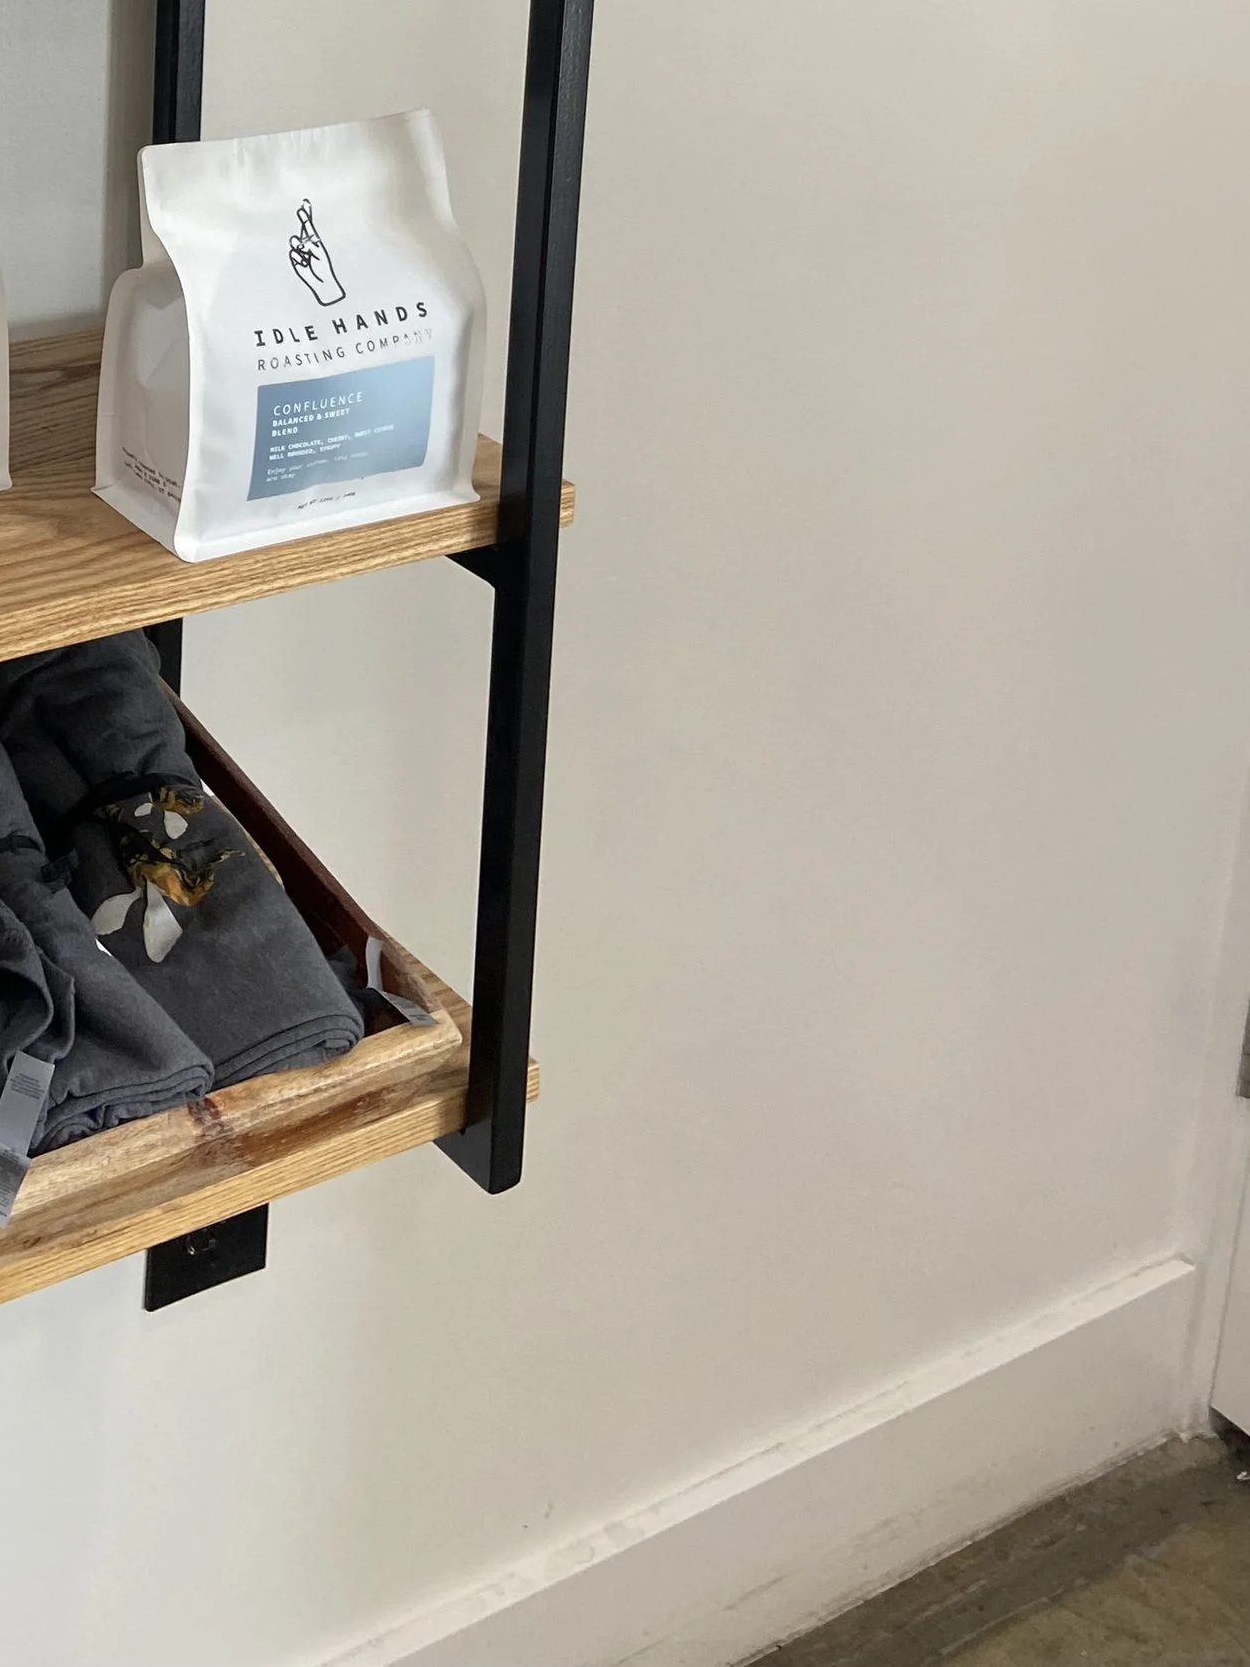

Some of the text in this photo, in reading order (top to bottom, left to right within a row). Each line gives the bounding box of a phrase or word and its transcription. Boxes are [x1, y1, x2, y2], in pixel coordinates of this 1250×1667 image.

[254, 302, 428, 347] IDLE HANDS
[257, 346, 345, 371] ROASTING
[273, 391, 363, 416] CONFLUENCE
[272, 412, 314, 428] BALANCED
[324, 408, 350, 419] SWEET
[271, 427, 299, 438] BLEND
